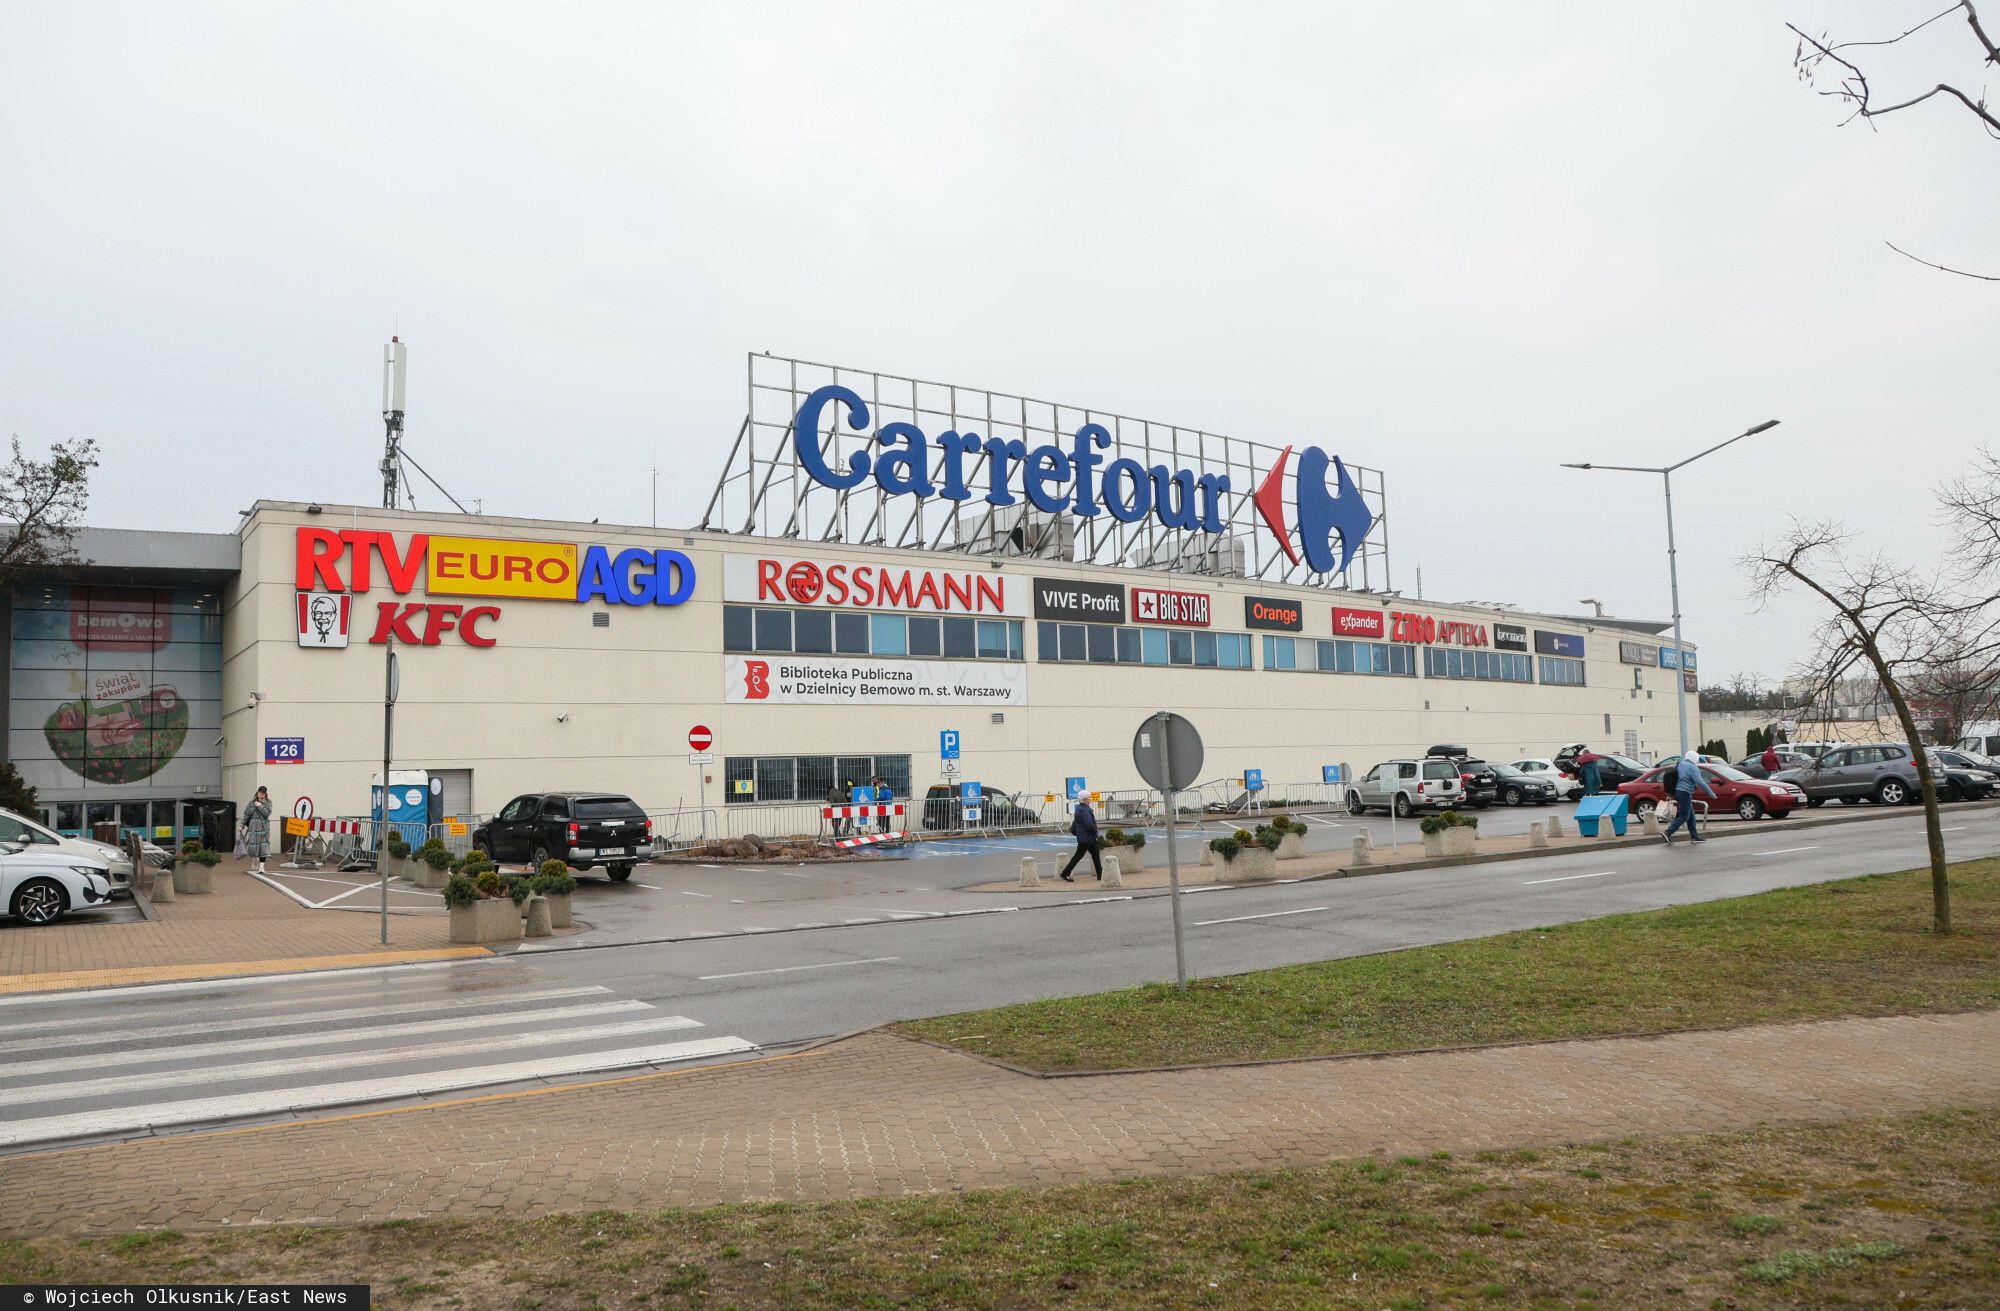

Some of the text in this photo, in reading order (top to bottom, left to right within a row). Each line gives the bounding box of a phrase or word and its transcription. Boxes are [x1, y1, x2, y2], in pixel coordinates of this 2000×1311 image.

[794, 385, 1231, 534] Carrefour
[296, 527, 696, 606] RTV EURO AGD
[758, 559, 1004, 612] ROSSMANN
[1043, 590, 1120, 612] VIVE Profit
[1160, 592, 1208, 623] BIG STAR
[369, 601, 501, 647] KFC
[1253, 602, 1297, 625] Orange
[1341, 612, 1378, 631] expander
[1438, 620, 1489, 647] APTEKA
[95, 671, 136, 692] świat
[780, 666, 913, 681] Biblioteka Publiczna
[96, 682, 141, 700] zakupów
[780, 683, 1011, 699] w Dzielnicy Bemowo m. st. Warszawy
[271, 744, 298, 757] 126
[945, 733, 956, 751] P
